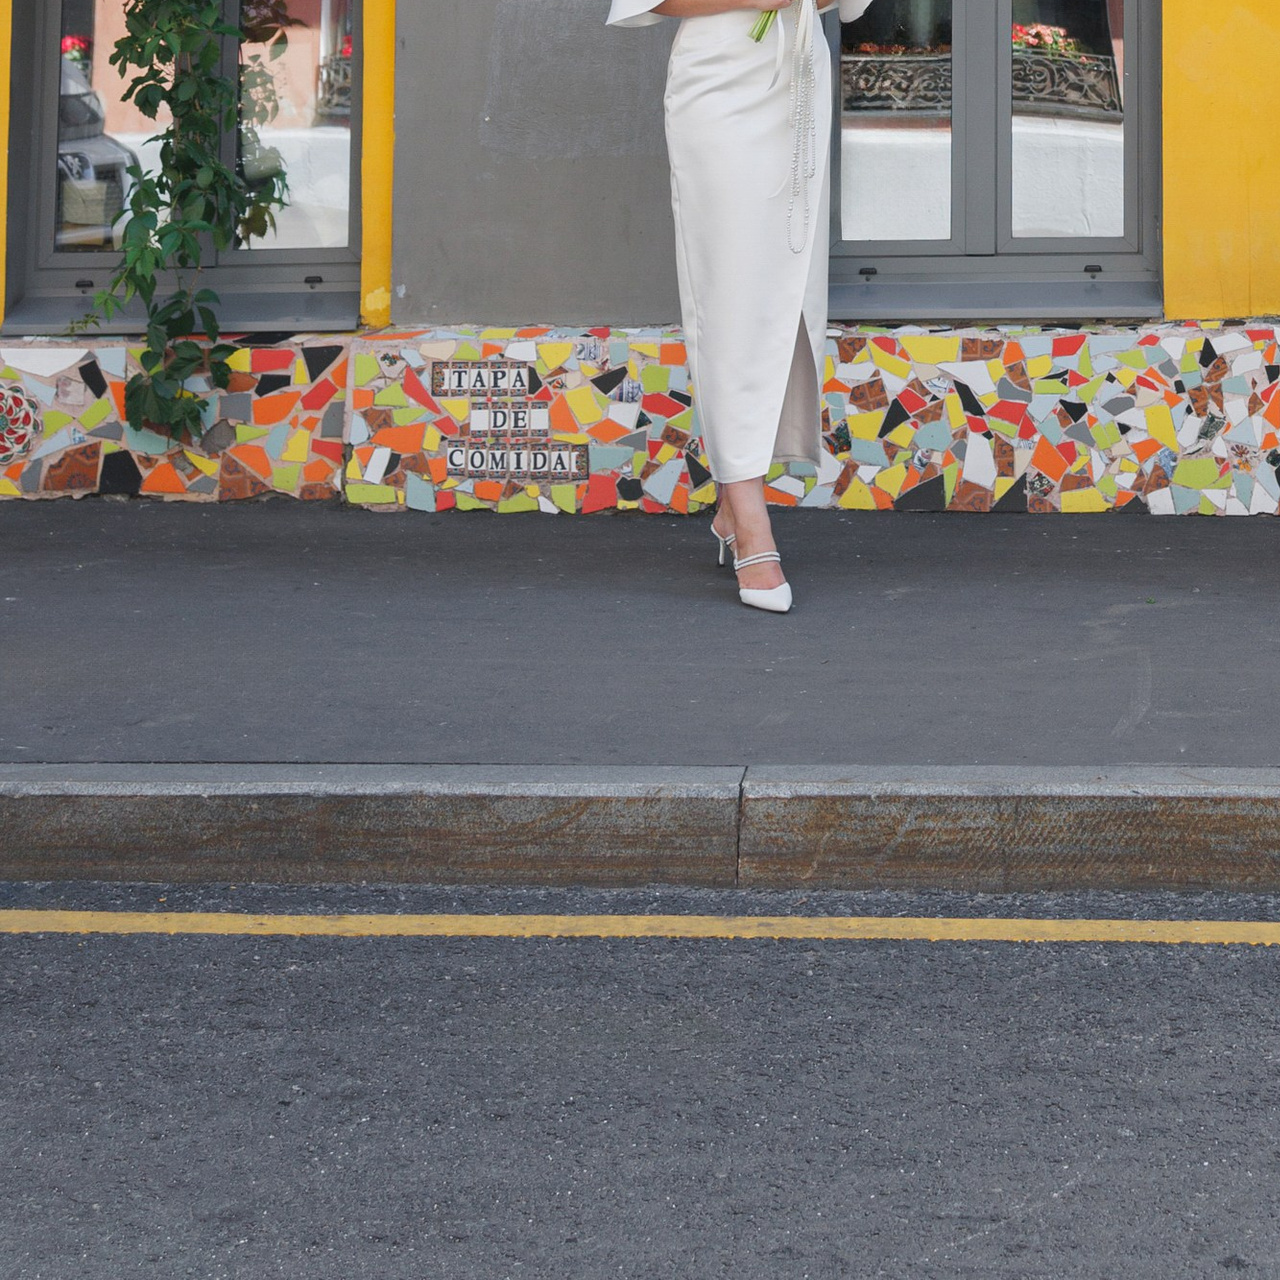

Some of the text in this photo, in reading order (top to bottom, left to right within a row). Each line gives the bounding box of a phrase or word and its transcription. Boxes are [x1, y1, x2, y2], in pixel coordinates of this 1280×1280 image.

[452, 369, 527, 389] TAPA
[491, 410, 528, 429] DE
[448, 448, 568, 472] COMIDA
